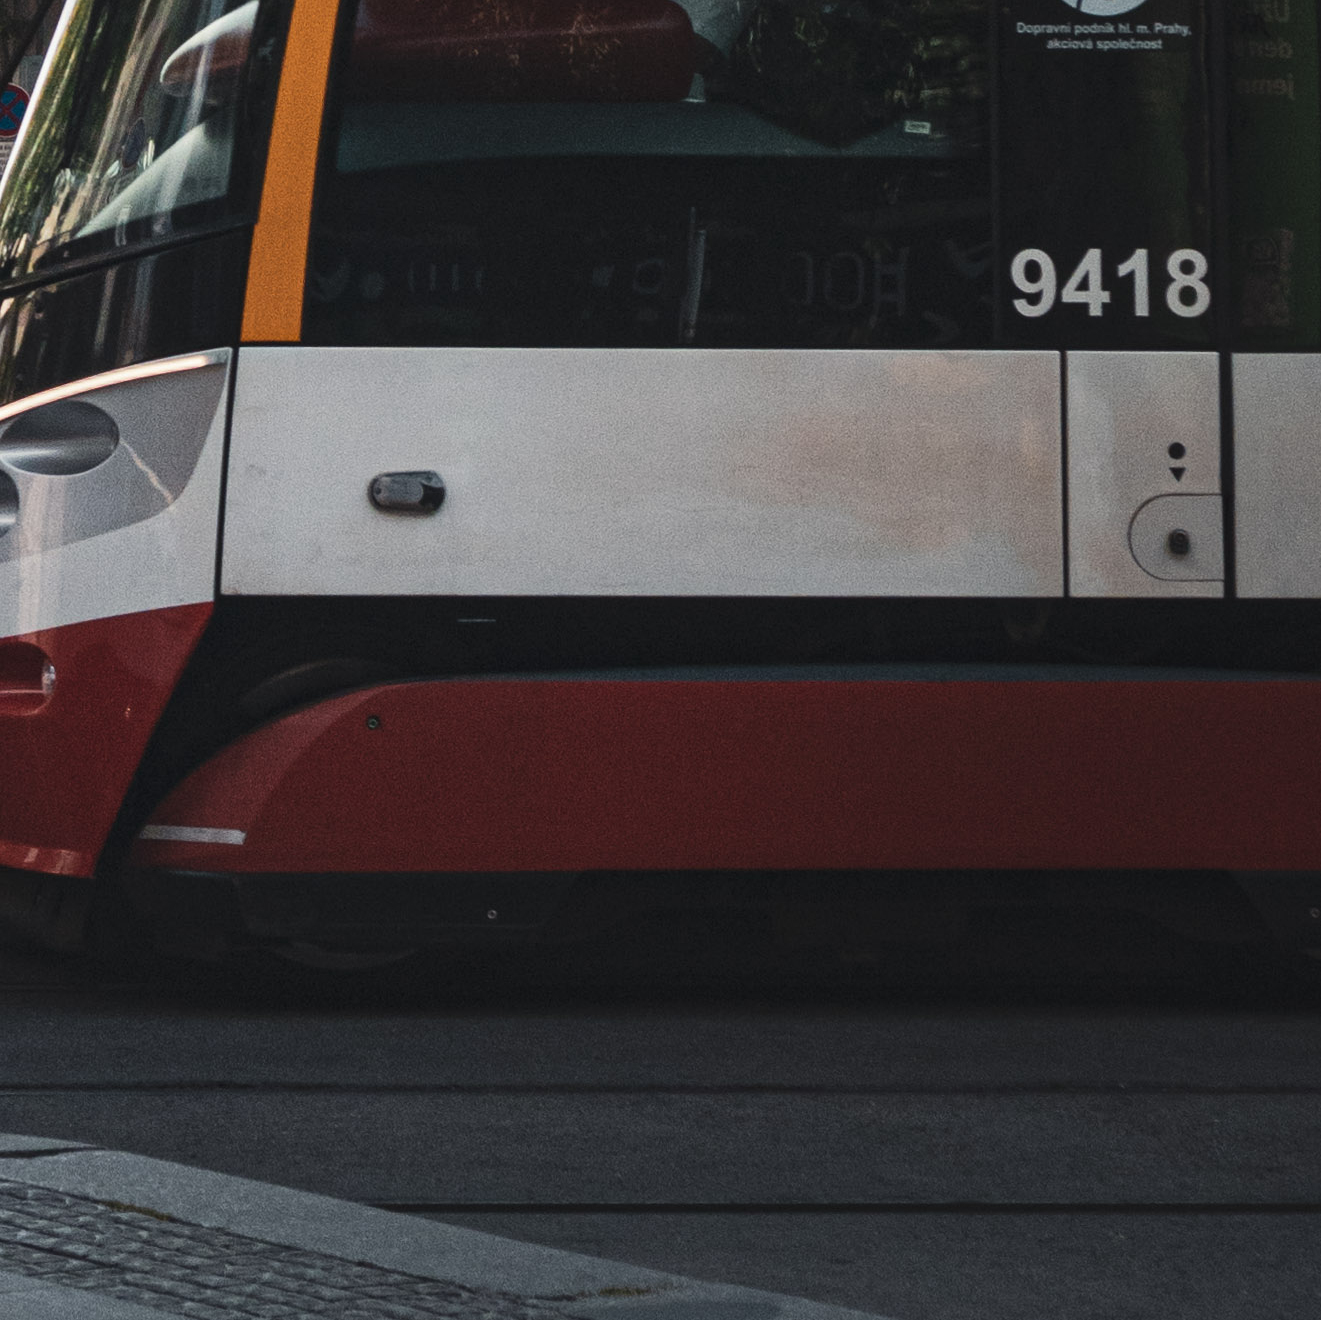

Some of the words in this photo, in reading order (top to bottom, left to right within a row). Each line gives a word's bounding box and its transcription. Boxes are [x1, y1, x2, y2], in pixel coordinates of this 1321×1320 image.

[1074, 22, 1115, 36] podnik
[1096, 38, 1163, 51] společnost
[1010, 248, 1211, 318] 9418
